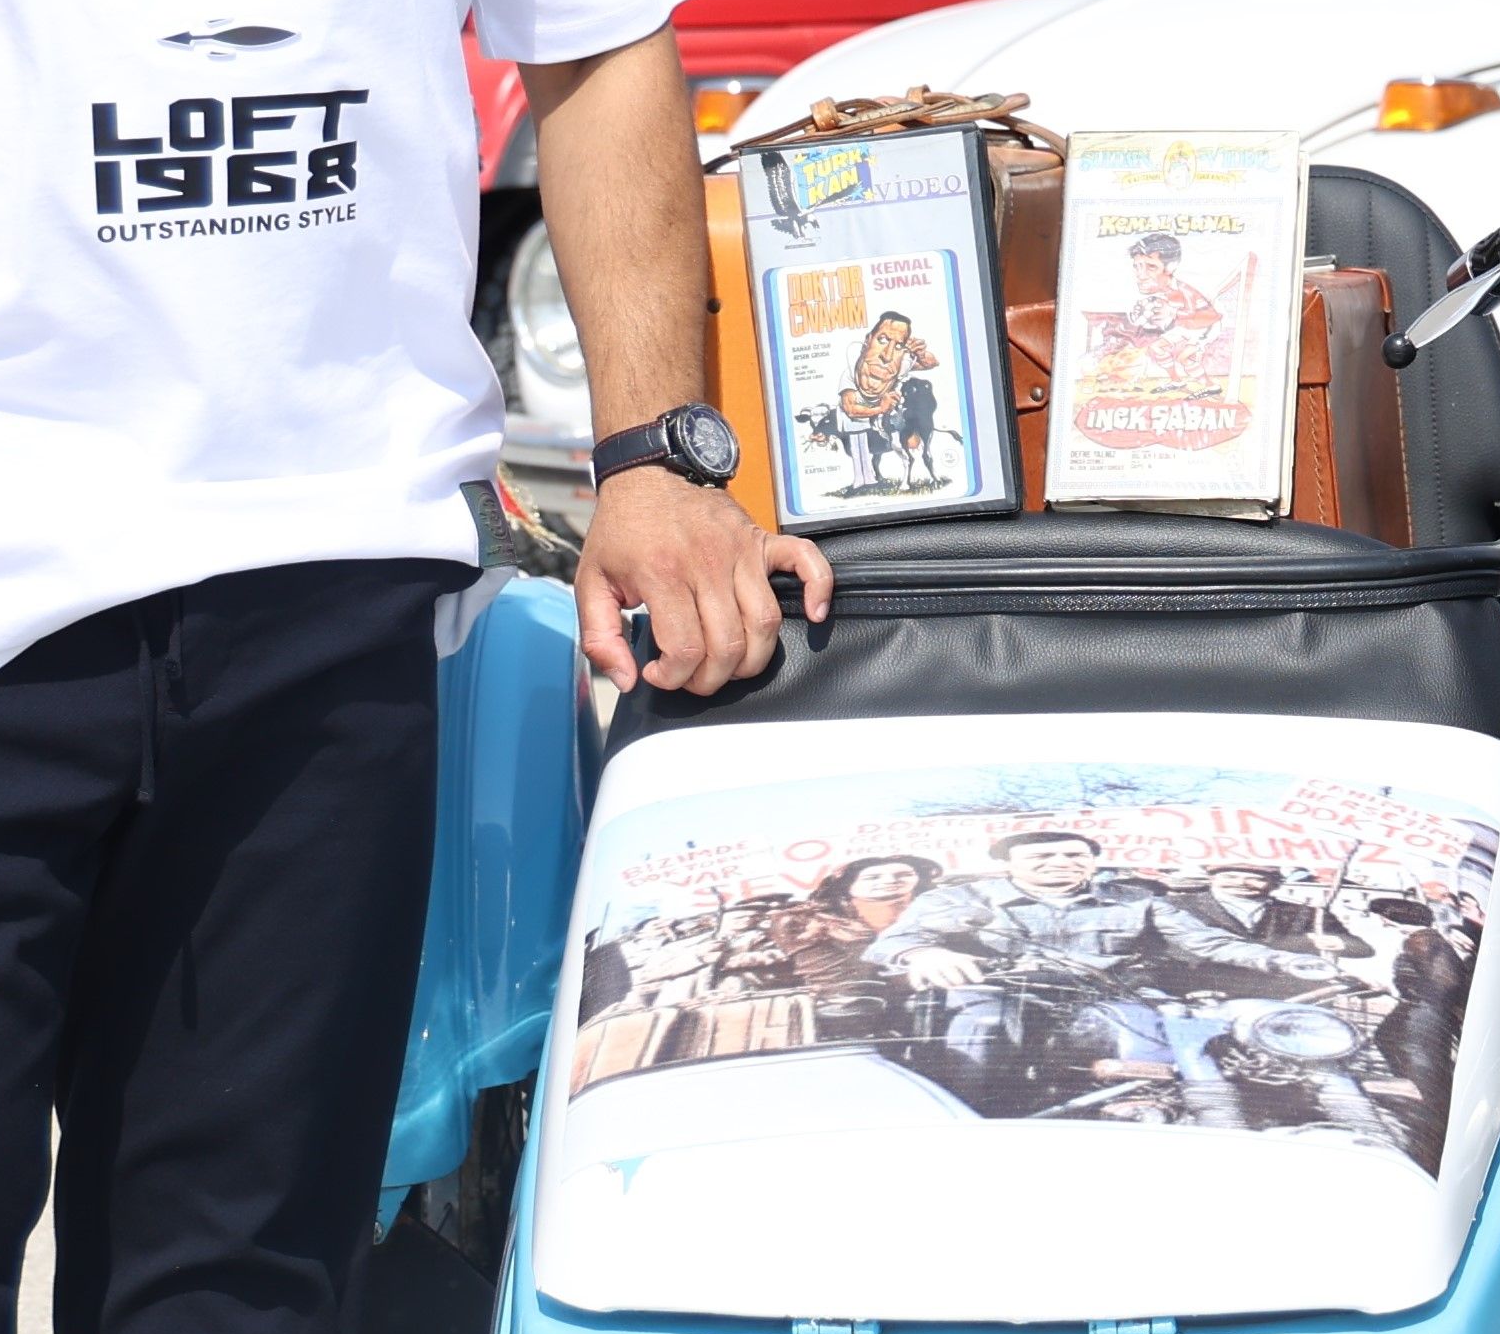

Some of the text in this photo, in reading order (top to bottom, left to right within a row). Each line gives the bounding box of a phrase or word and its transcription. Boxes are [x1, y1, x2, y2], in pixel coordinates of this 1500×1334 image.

[92, 89, 370, 156] LOFT
[94, 141, 357, 215] 1968
[97, 202, 357, 243] OUTSTANDING STYLE
[787, 265, 865, 305] DOKTOR
[871, 257, 933, 276] KEMAL
[873, 273, 932, 291] SUNAL
[984, 818, 1121, 833] BENDE
[1280, 799, 1463, 859] DOKTOR
